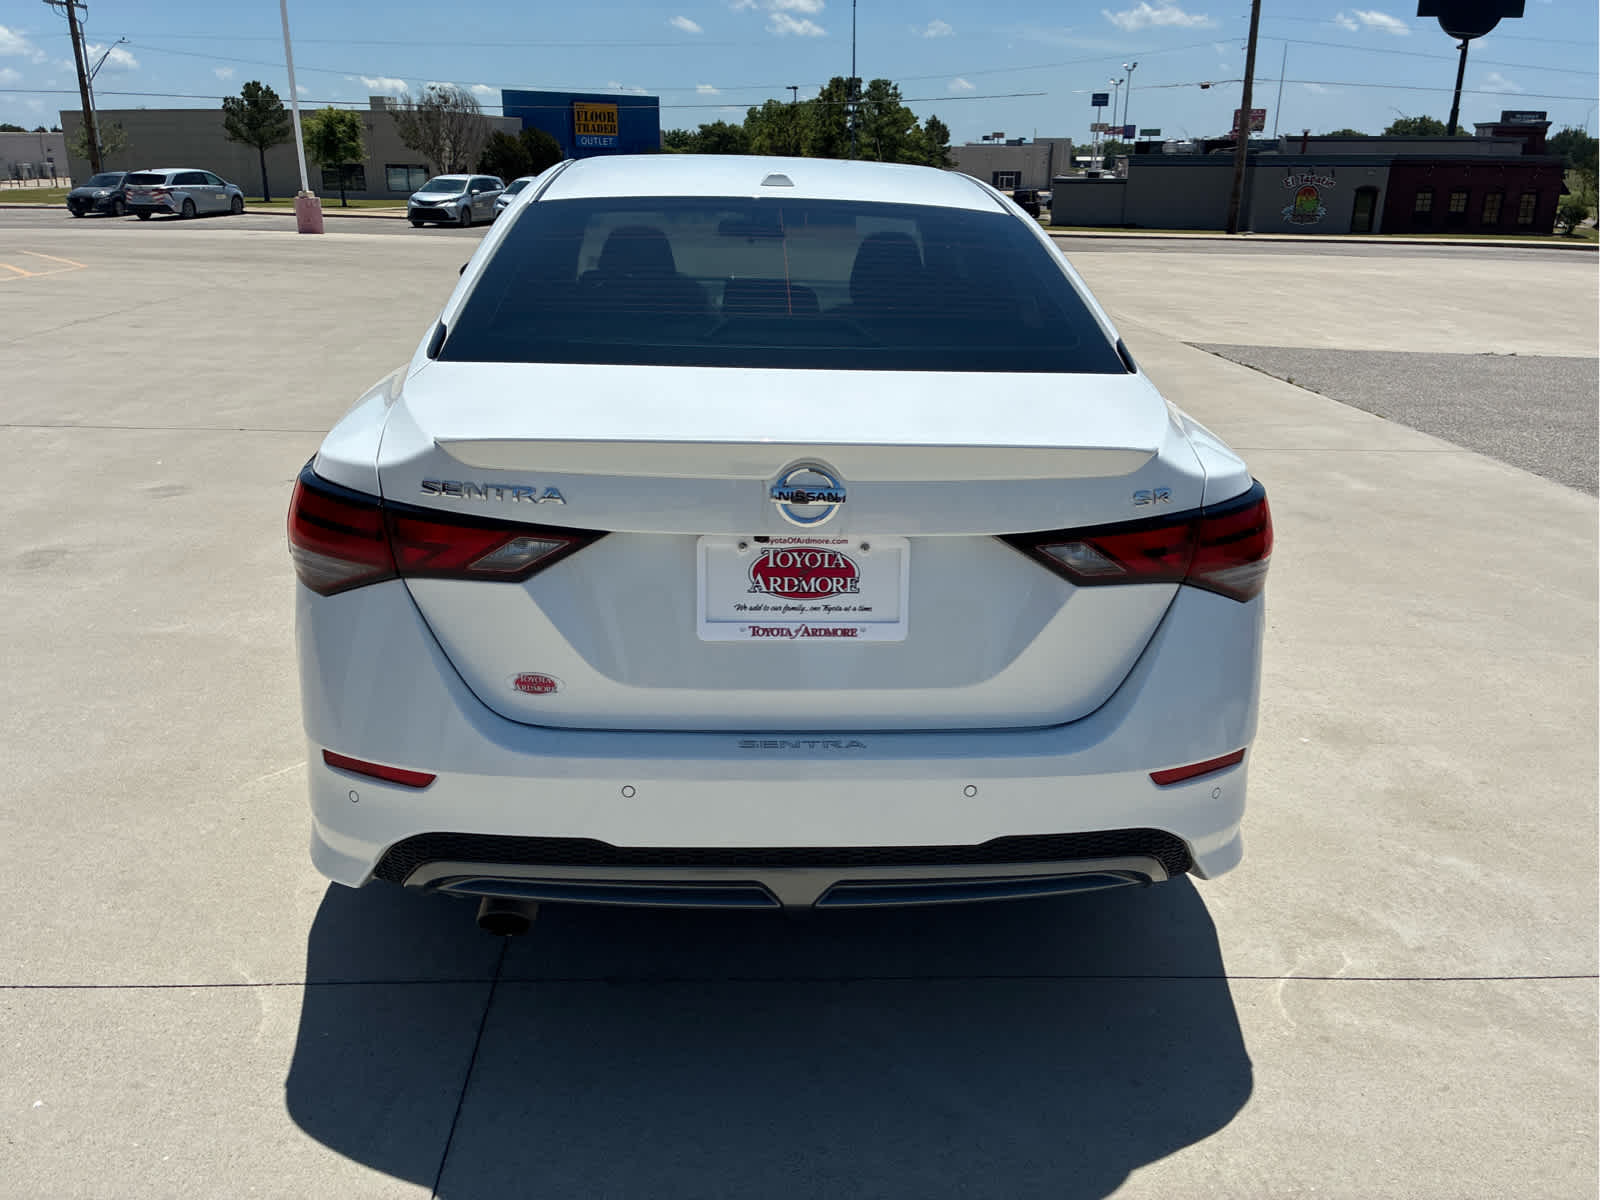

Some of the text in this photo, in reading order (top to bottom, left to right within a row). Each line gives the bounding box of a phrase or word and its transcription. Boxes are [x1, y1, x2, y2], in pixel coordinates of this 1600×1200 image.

[576, 111, 615, 122] FLOOR
[576, 123, 617, 134] TRADER
[580, 136, 614, 146] OUTLET
[420, 479, 567, 505] SENTRA
[776, 491, 846, 504] NISSAN
[1133, 487, 1173, 507] SR
[763, 535, 848, 546] yotaOfArdmore.com
[761, 547, 848, 569] TOYOTA
[747, 573, 861, 594] ARDMORE
[748, 625, 793, 638] TOYOTA
[800, 626, 858, 638] ARDMORE
[518, 672, 553, 685] TOYOTA
[737, 738, 868, 750] SENTRA
